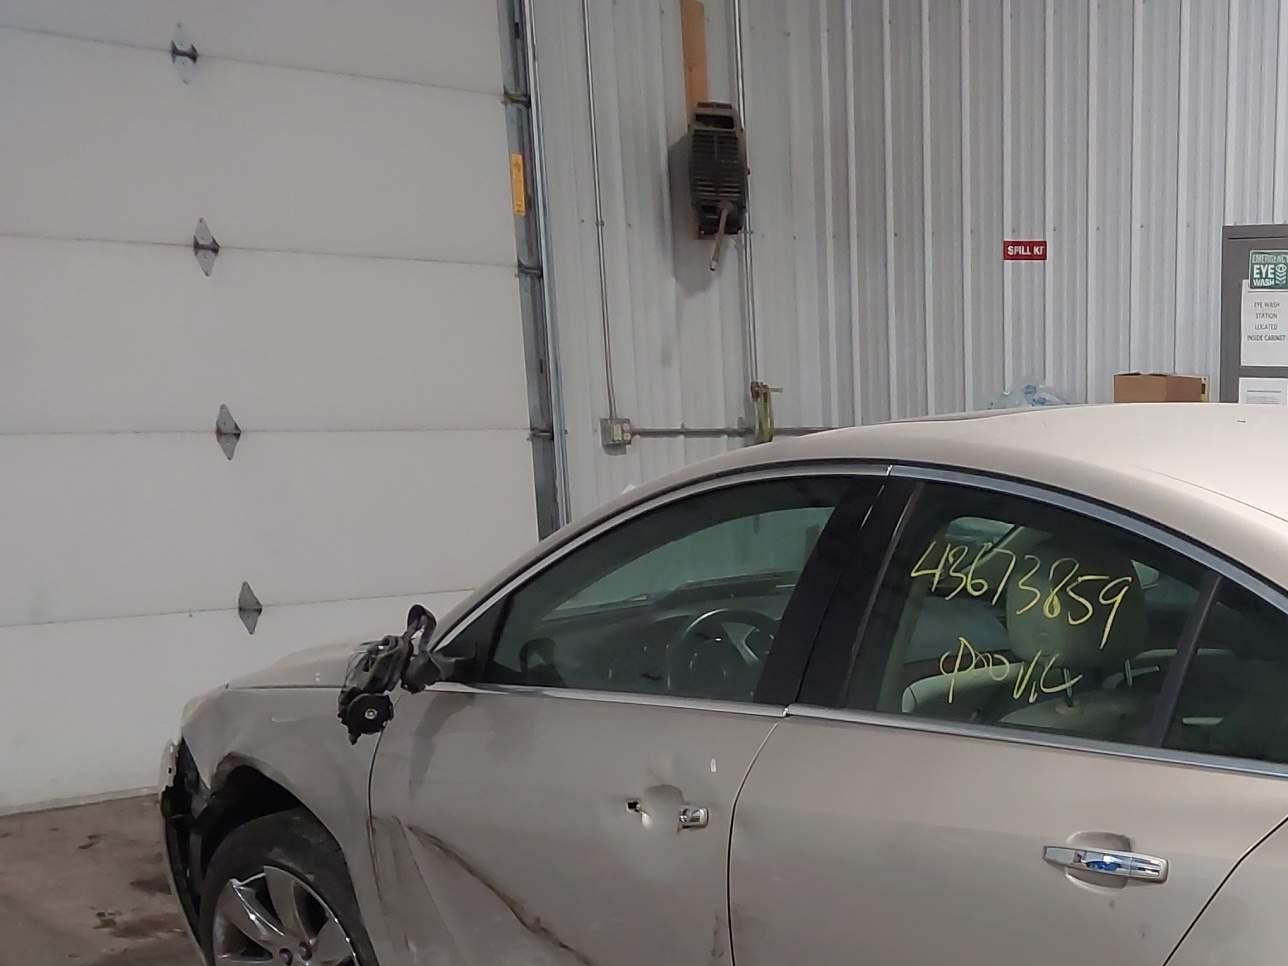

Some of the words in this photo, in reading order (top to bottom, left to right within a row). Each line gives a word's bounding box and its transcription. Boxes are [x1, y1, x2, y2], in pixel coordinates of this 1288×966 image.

[1007, 245, 1032, 256] SPILL
[1253, 264, 1275, 279] EYE
[1253, 278, 1275, 287] WASH
[910, 540, 1132, 650] 43673859
